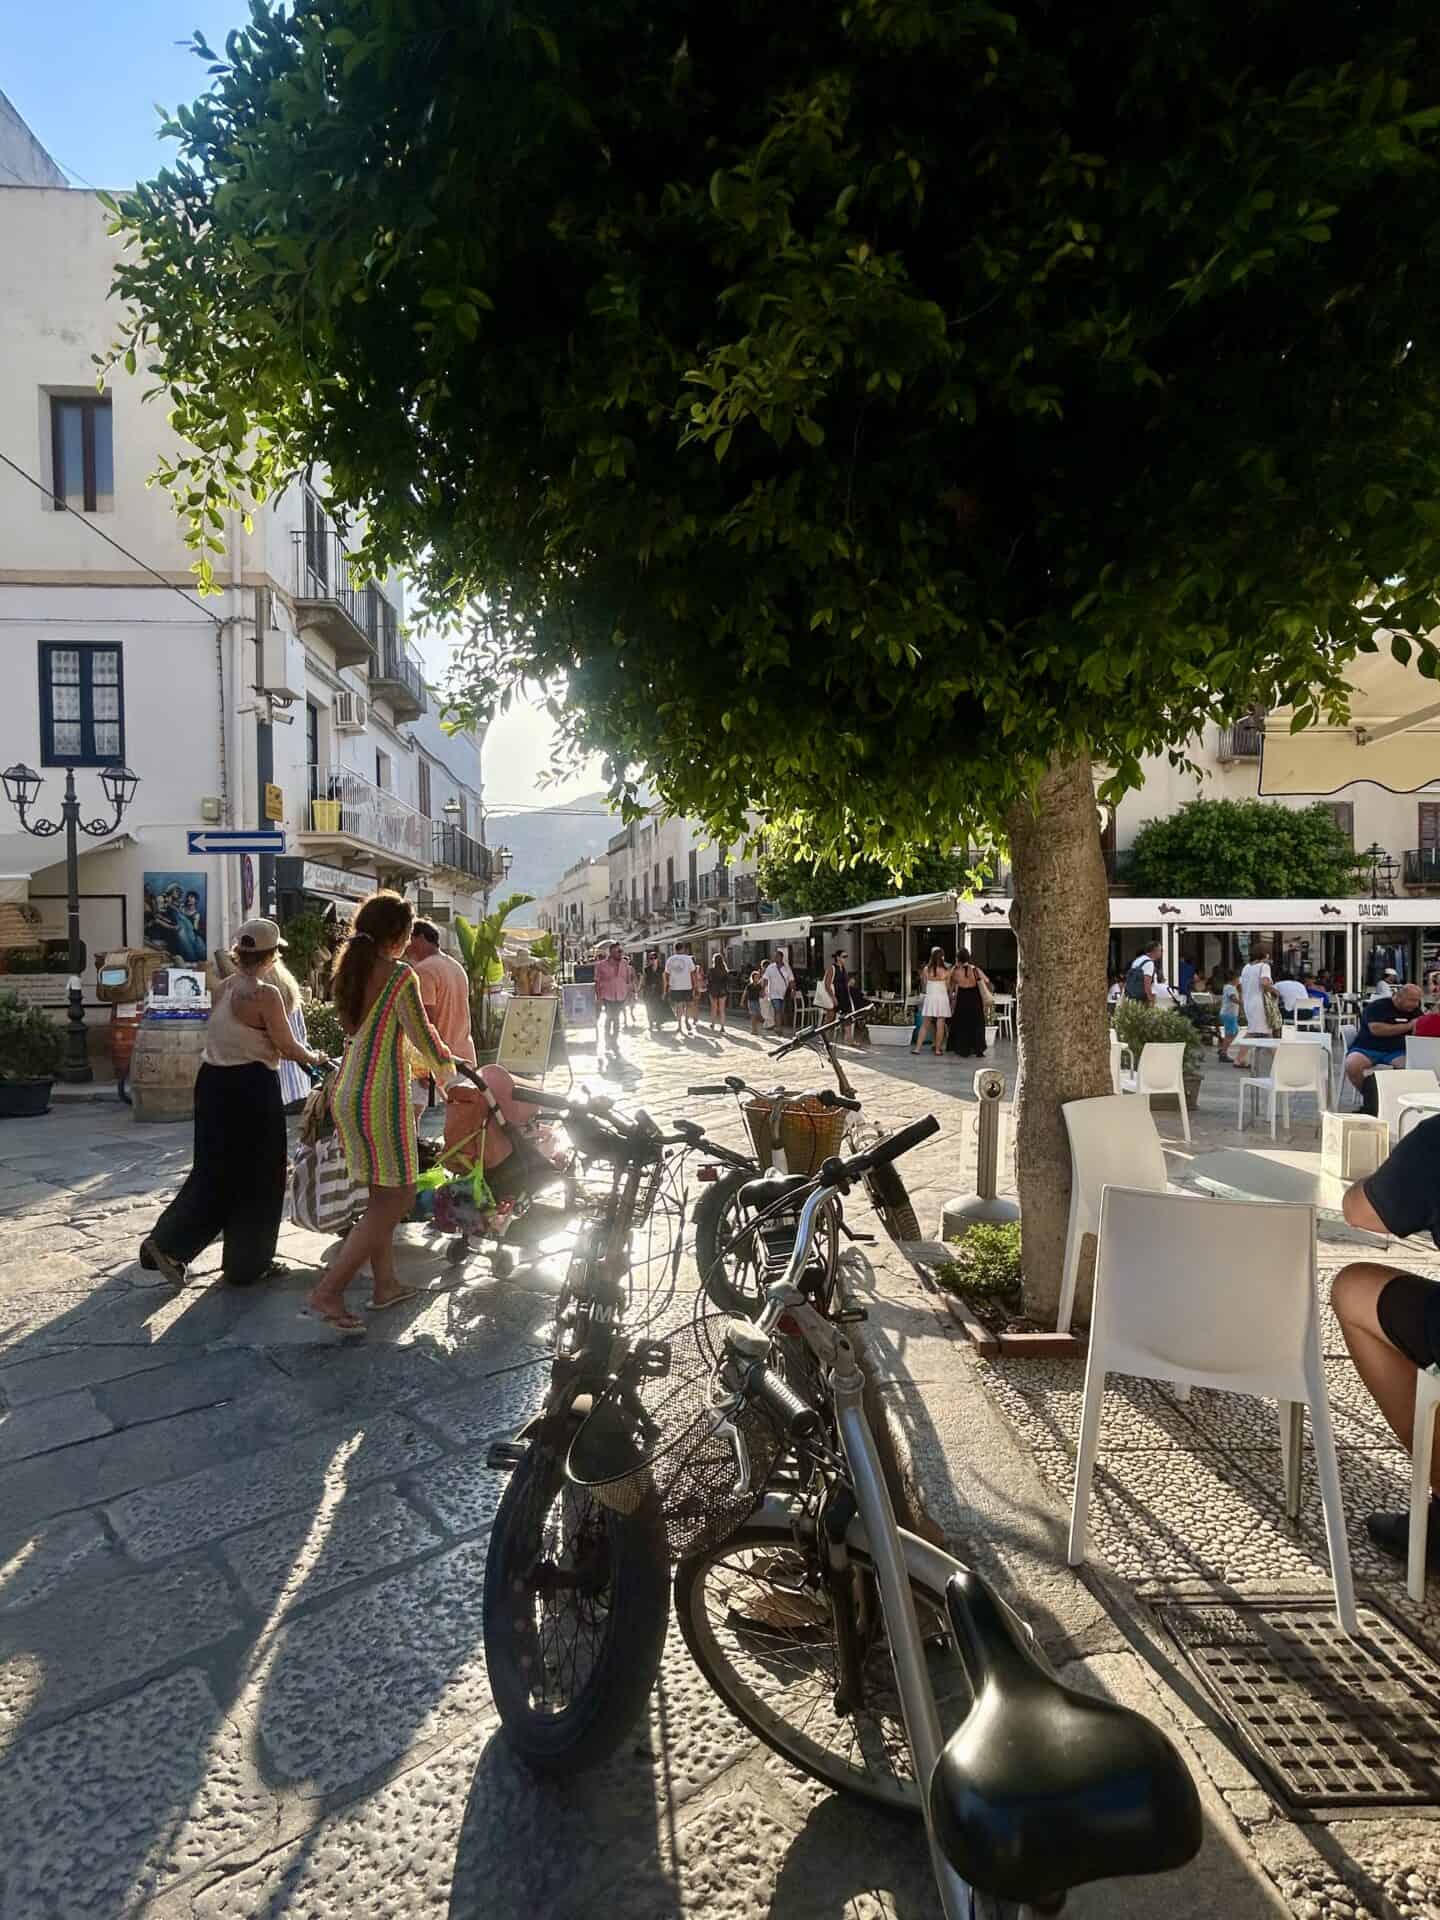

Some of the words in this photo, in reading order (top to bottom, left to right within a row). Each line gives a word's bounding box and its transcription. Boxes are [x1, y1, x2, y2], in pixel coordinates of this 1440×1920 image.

[1199, 903, 1213, 916] DAI
[1214, 903, 1232, 916] CONI
[1358, 903, 1371, 917] DAI
